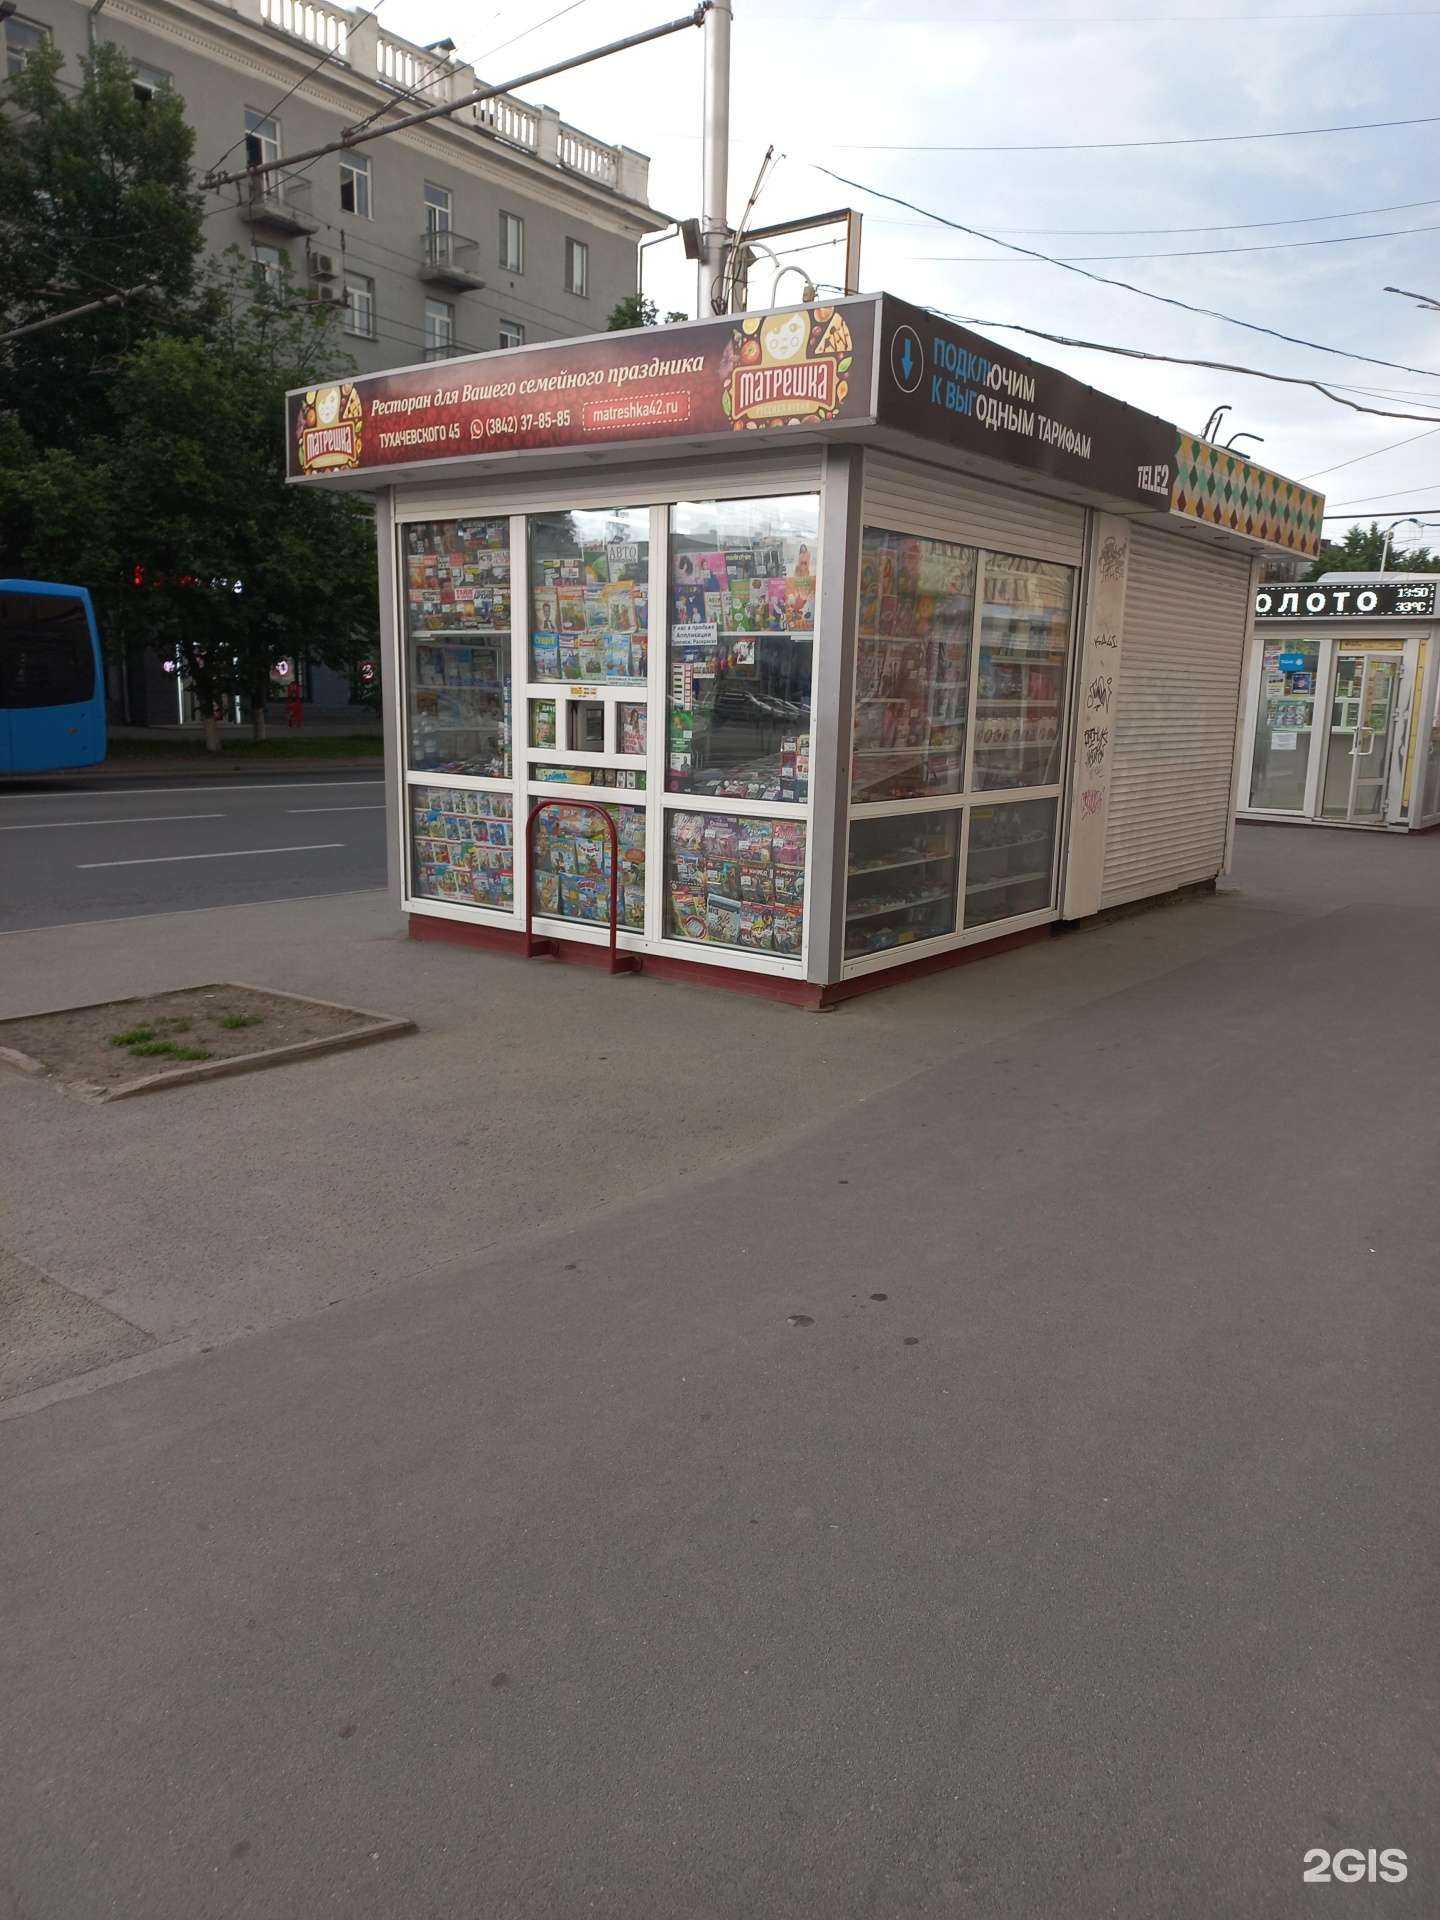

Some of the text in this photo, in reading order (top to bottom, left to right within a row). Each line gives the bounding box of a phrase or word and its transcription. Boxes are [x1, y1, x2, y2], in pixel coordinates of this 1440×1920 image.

[371, 355, 705, 417] Ресторан для Вашего семейного праздника
[933, 337, 1036, 403] ПОДКЛЮЧИМ
[379, 409, 571, 448] ТУХАЧЕВСКОГО 45 (3842) 37-85-85
[593, 399, 678, 423] matreshka42.ru
[931, 374, 1092, 460] К ВЫГОДНЫМ ТАРИФАМ
[1137, 464, 1170, 496] TELE2
